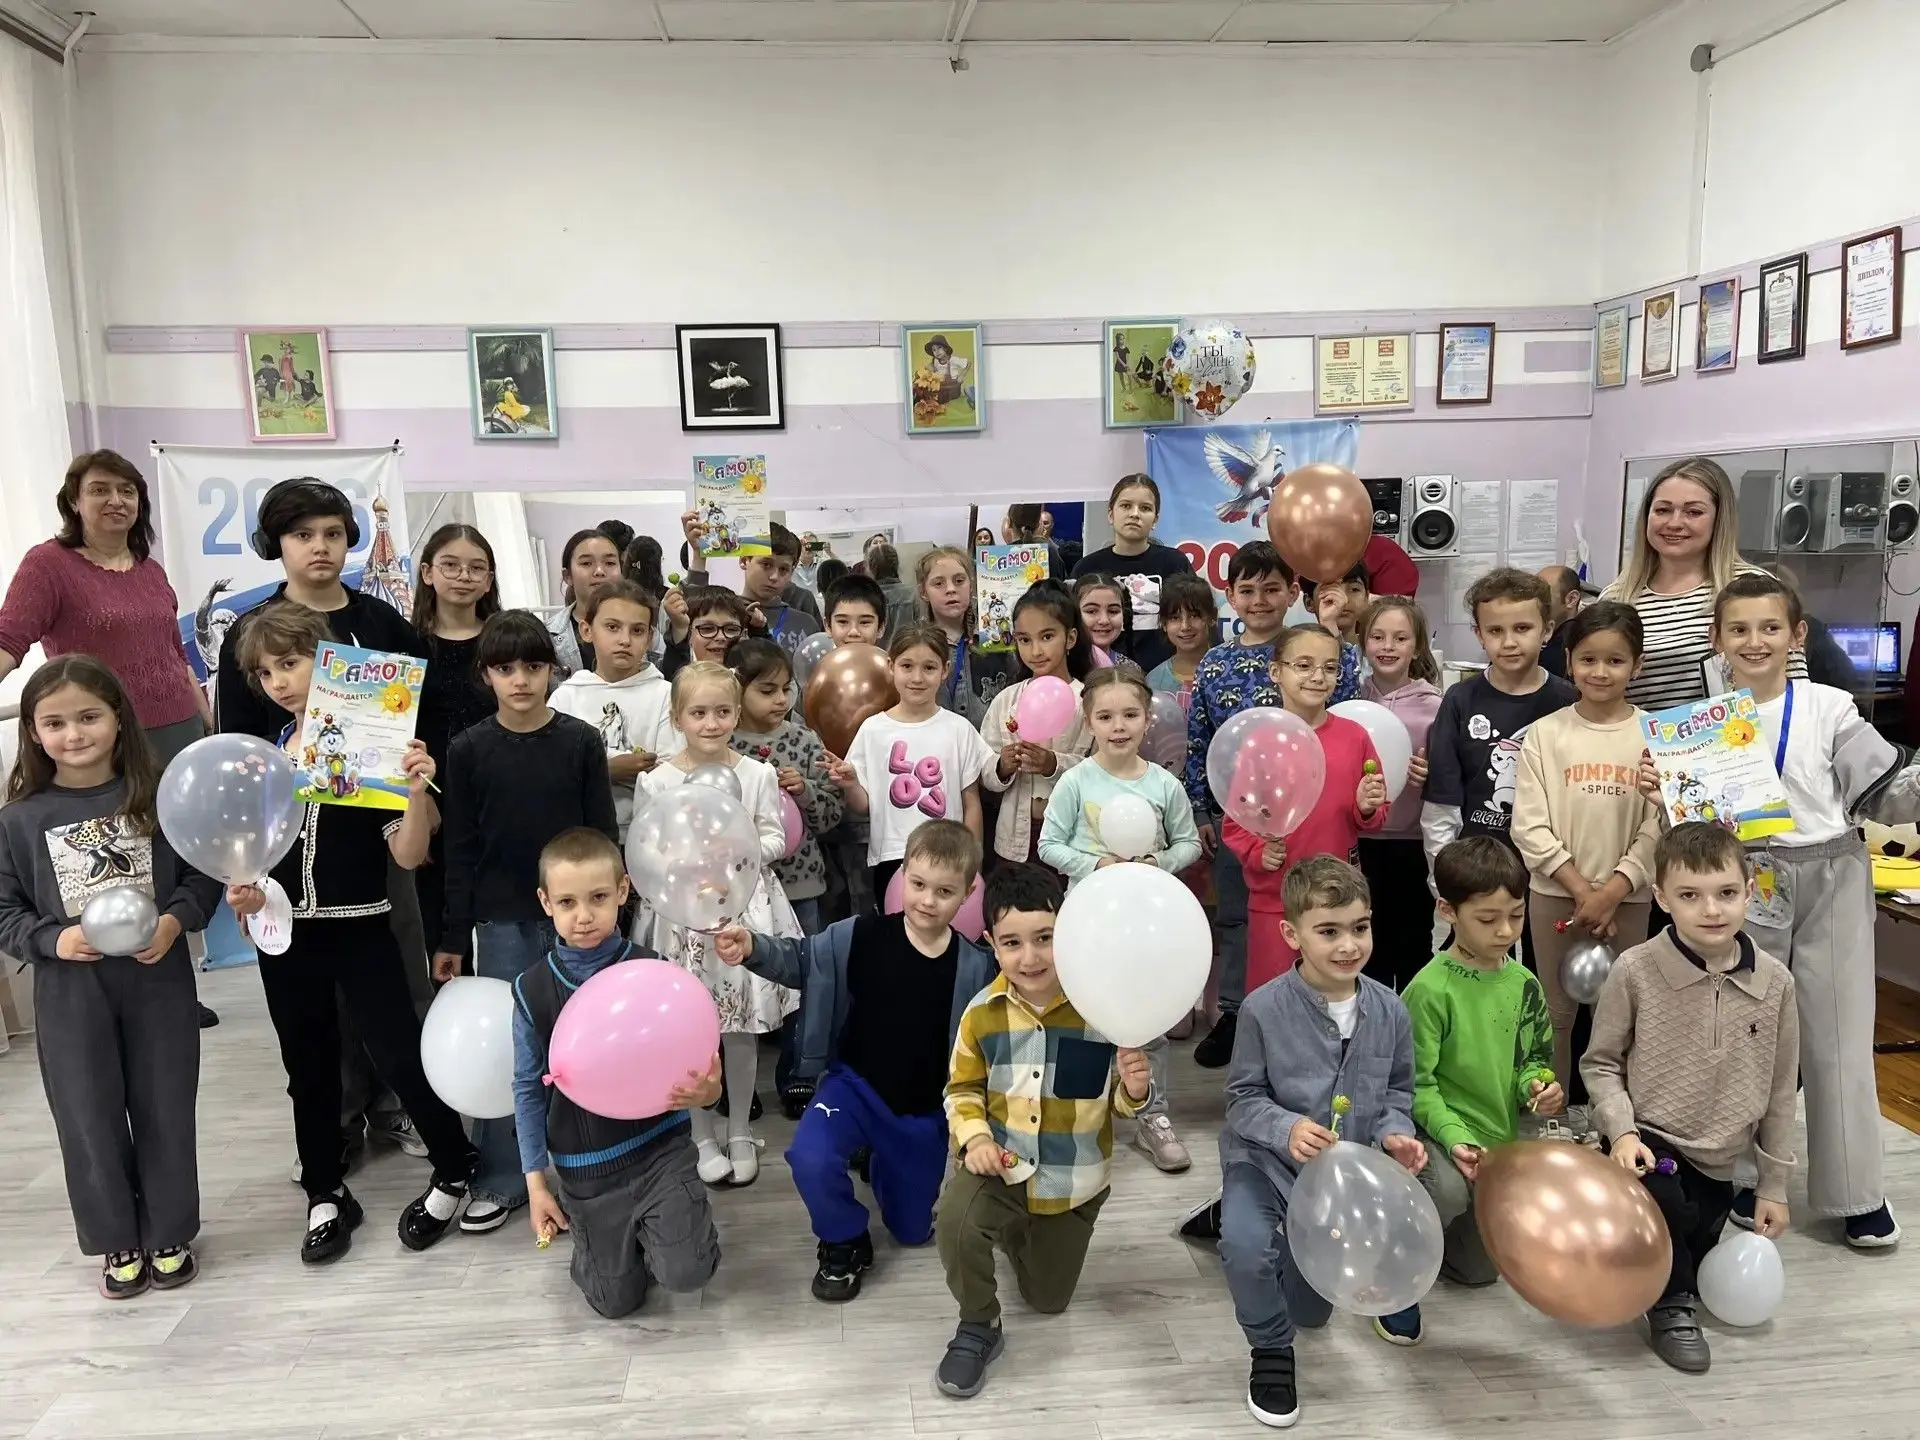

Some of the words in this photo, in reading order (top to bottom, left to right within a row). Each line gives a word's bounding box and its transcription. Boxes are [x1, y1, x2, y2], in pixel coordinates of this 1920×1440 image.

[1200, 344, 1224, 357] ТЫ
[981, 547, 1048, 571] ГРАМОТА
[321, 648, 425, 686] ГРАМОТА
[316, 684, 373, 701] НАГРАЖДАЕТСЯ
[1648, 696, 1756, 742] ГРАМОТА
[1656, 738, 1714, 757] НАГРАЖДАЕТСЯ
